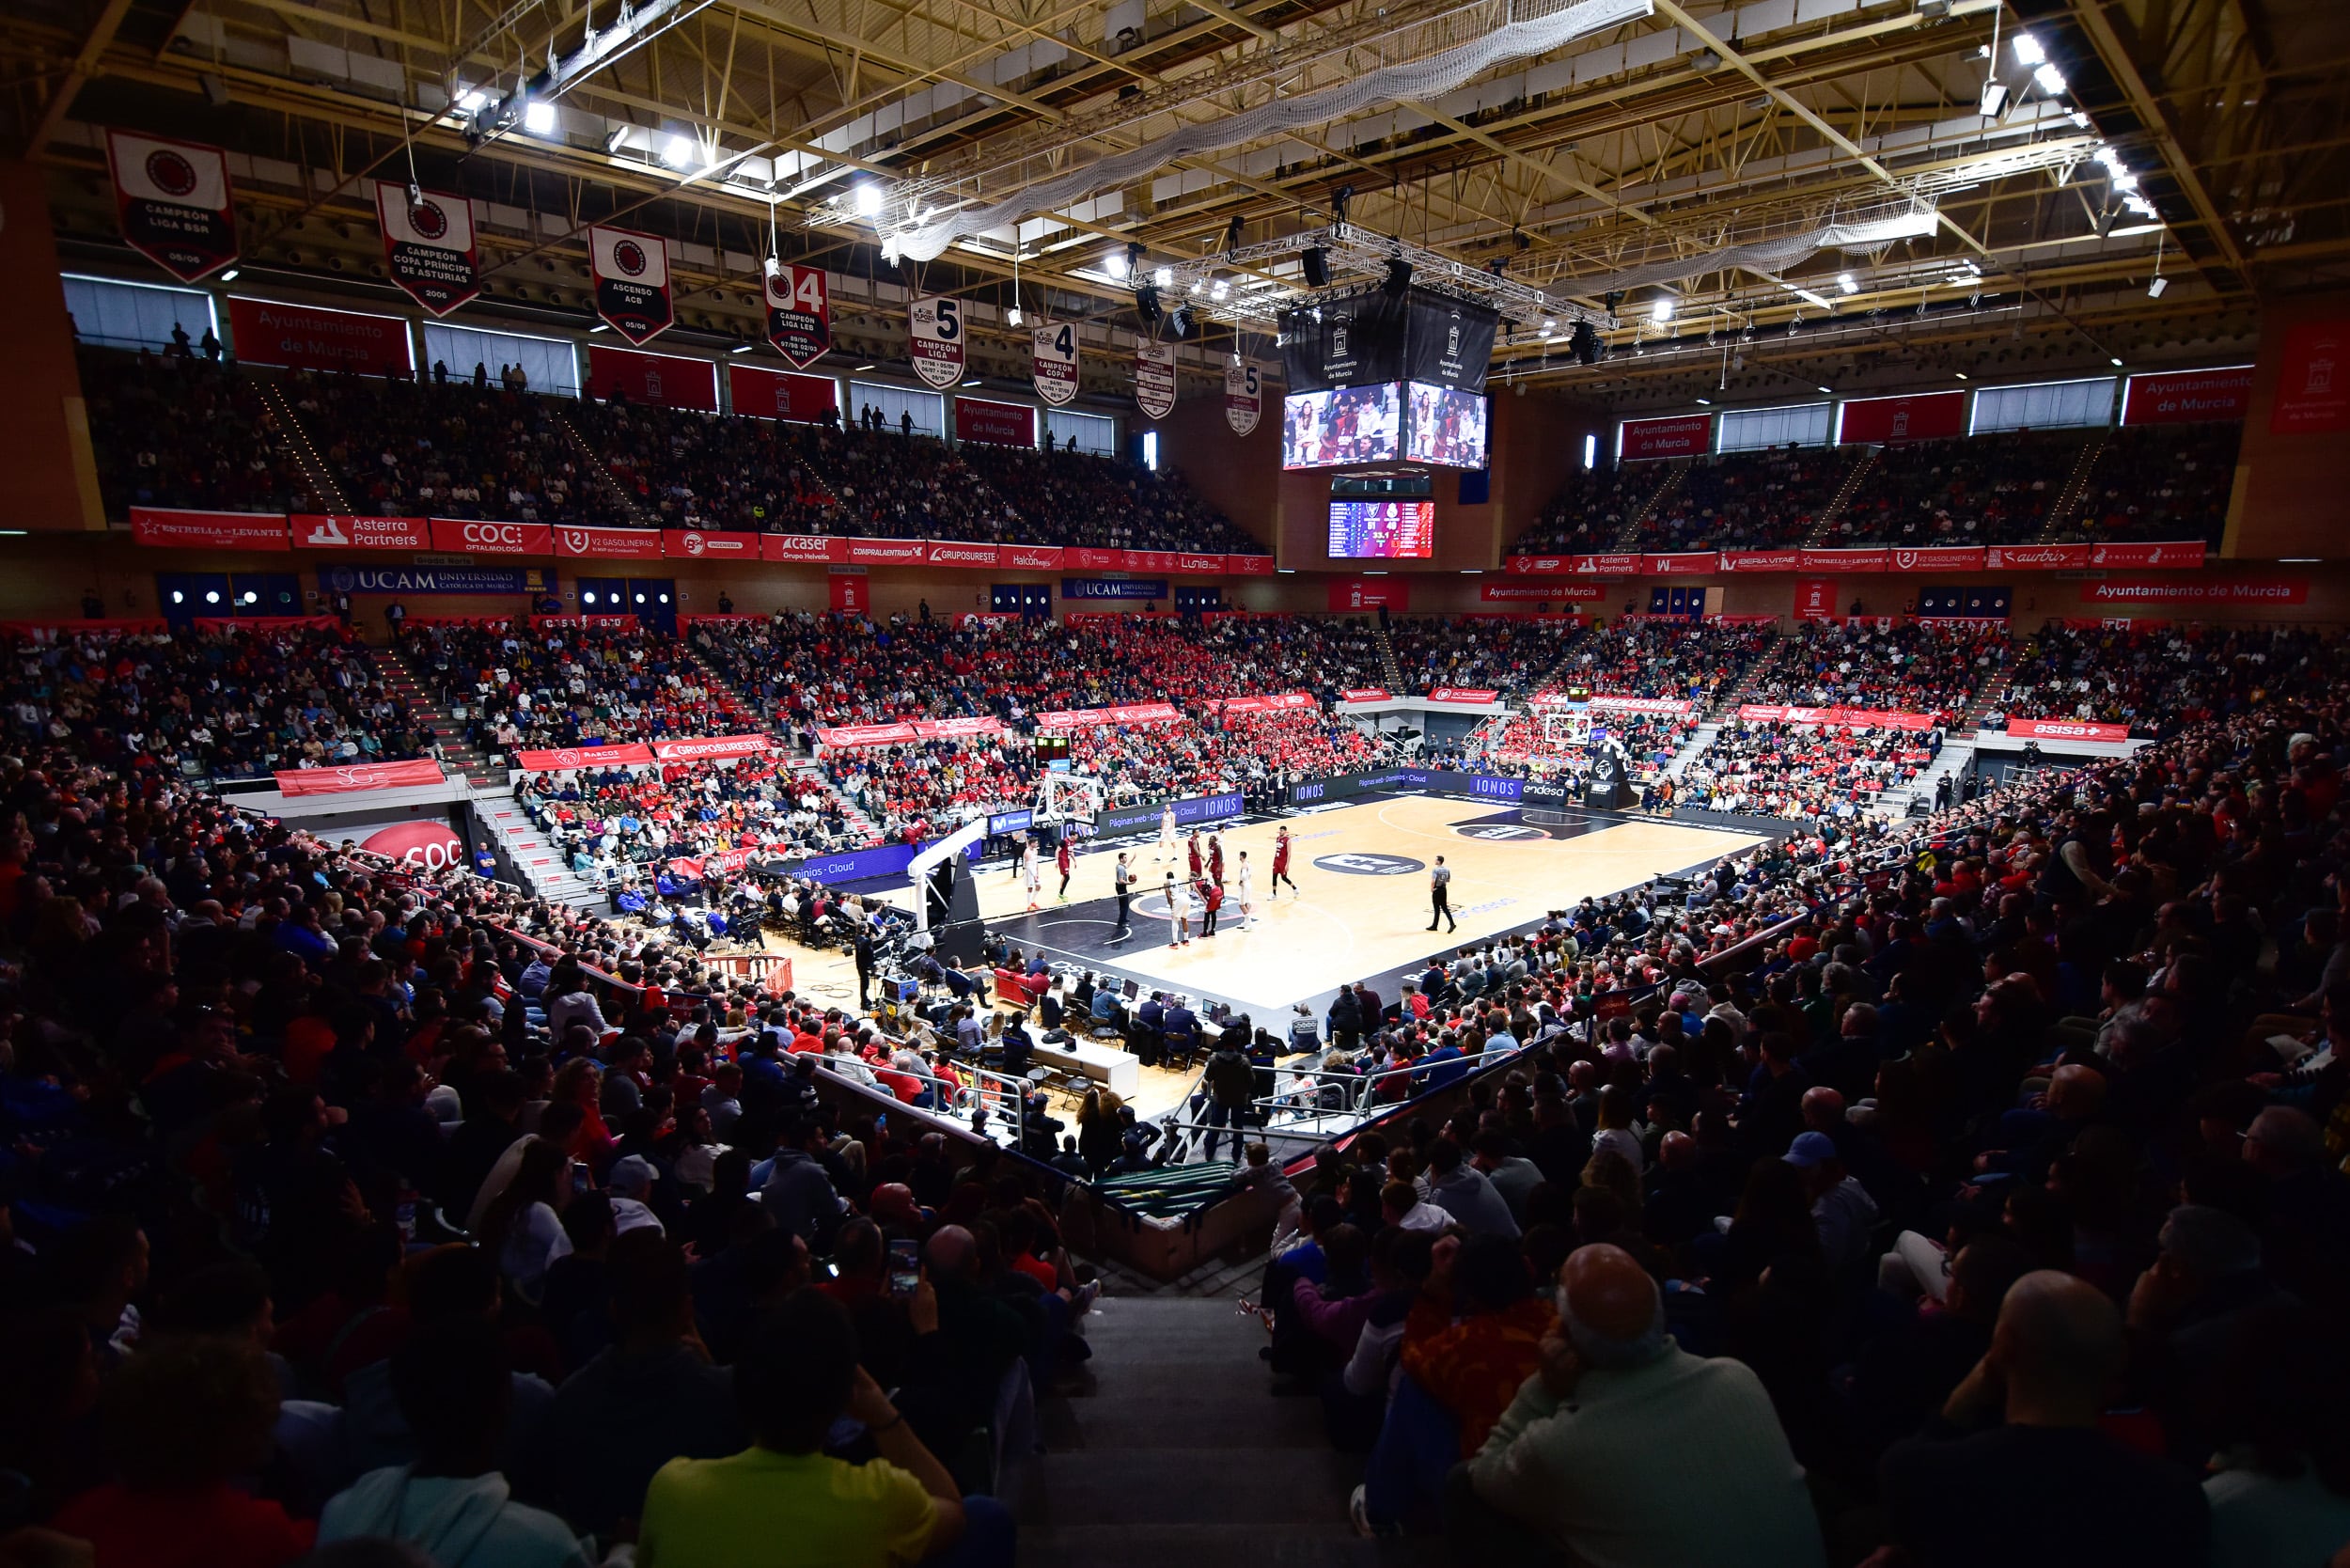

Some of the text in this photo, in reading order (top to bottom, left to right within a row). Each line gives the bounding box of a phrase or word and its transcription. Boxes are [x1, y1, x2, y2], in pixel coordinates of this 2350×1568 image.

[145, 204, 209, 222] CAMPEÓN
[150, 218, 210, 233] LIGA BSR
[406, 246, 457, 261] CAMPEÓN
[393, 255, 472, 274] COPA PRÍNCIPE
[400, 266, 467, 284] DE ASTURIAS
[425, 290, 447, 299] 2006
[613, 284, 652, 295] ASCENSO
[796, 273, 823, 312] 4
[625, 296, 643, 305] ACB
[258, 310, 384, 338] Ayuntamiento
[780, 312, 815, 323] CAMPEÓN
[936, 300, 959, 339] 5
[626, 321, 647, 330] 05/06
[782, 321, 799, 329] LIGA
[280, 337, 369, 361] de Murcia
[917, 340, 957, 353] CAMPEÓN
[1055, 325, 1073, 360] 4
[929, 350, 948, 359] LIGA
[1039, 361, 1072, 372] CAMPEÓN
[1324, 361, 1357, 371] Ayuntamiento
[1439, 359, 1463, 370] Ayuntamiento
[1246, 367, 1258, 395] 5
[2156, 397, 2236, 412] de Murcia
[963, 403, 1023, 421] Ayuntamiento
[972, 422, 1015, 436] de Murcia
[1632, 422, 1701, 436] Ayuntamiento
[1641, 437, 1690, 450] de Murcia
[162, 525, 282, 538] ESTRELLA LEVANTE
[352, 519, 408, 531] Asterra
[354, 534, 417, 547] Partners
[591, 538, 654, 547] V2 GASOLINERAS
[791, 538, 829, 551] caser
[466, 544, 525, 553] OFTALMOLOGÍA
[854, 547, 912, 557] COMPRALAENTRADA
[941, 552, 996, 562] GRUPOSURESTE
[358, 572, 437, 589] UCAM
[438, 572, 513, 581] UNIVERSIDAD
[1086, 583, 1120, 596] UCAM
[1489, 587, 1596, 597] Ayuntamiento de Murcia
[2096, 585, 2292, 598] Ayuntamiento de Murcia
[1589, 698, 1686, 711] PIMENTONERA
[1128, 707, 1175, 720] CaixaBank
[677, 739, 765, 756] GRUPOSURESTE
[1295, 784, 1324, 801] IONOS
[1359, 778, 1374, 788] Páginas
[1408, 775, 1426, 783] Cloud
[1476, 778, 1565, 797] IONOS endesa
[1109, 816, 1134, 829] Páginas
[1135, 814, 1147, 823] web
[1181, 806, 1197, 816] Cloud
[1205, 797, 1237, 816] IONOS
[1008, 816, 1028, 825] Movistar
[828, 861, 855, 873] Cloud
